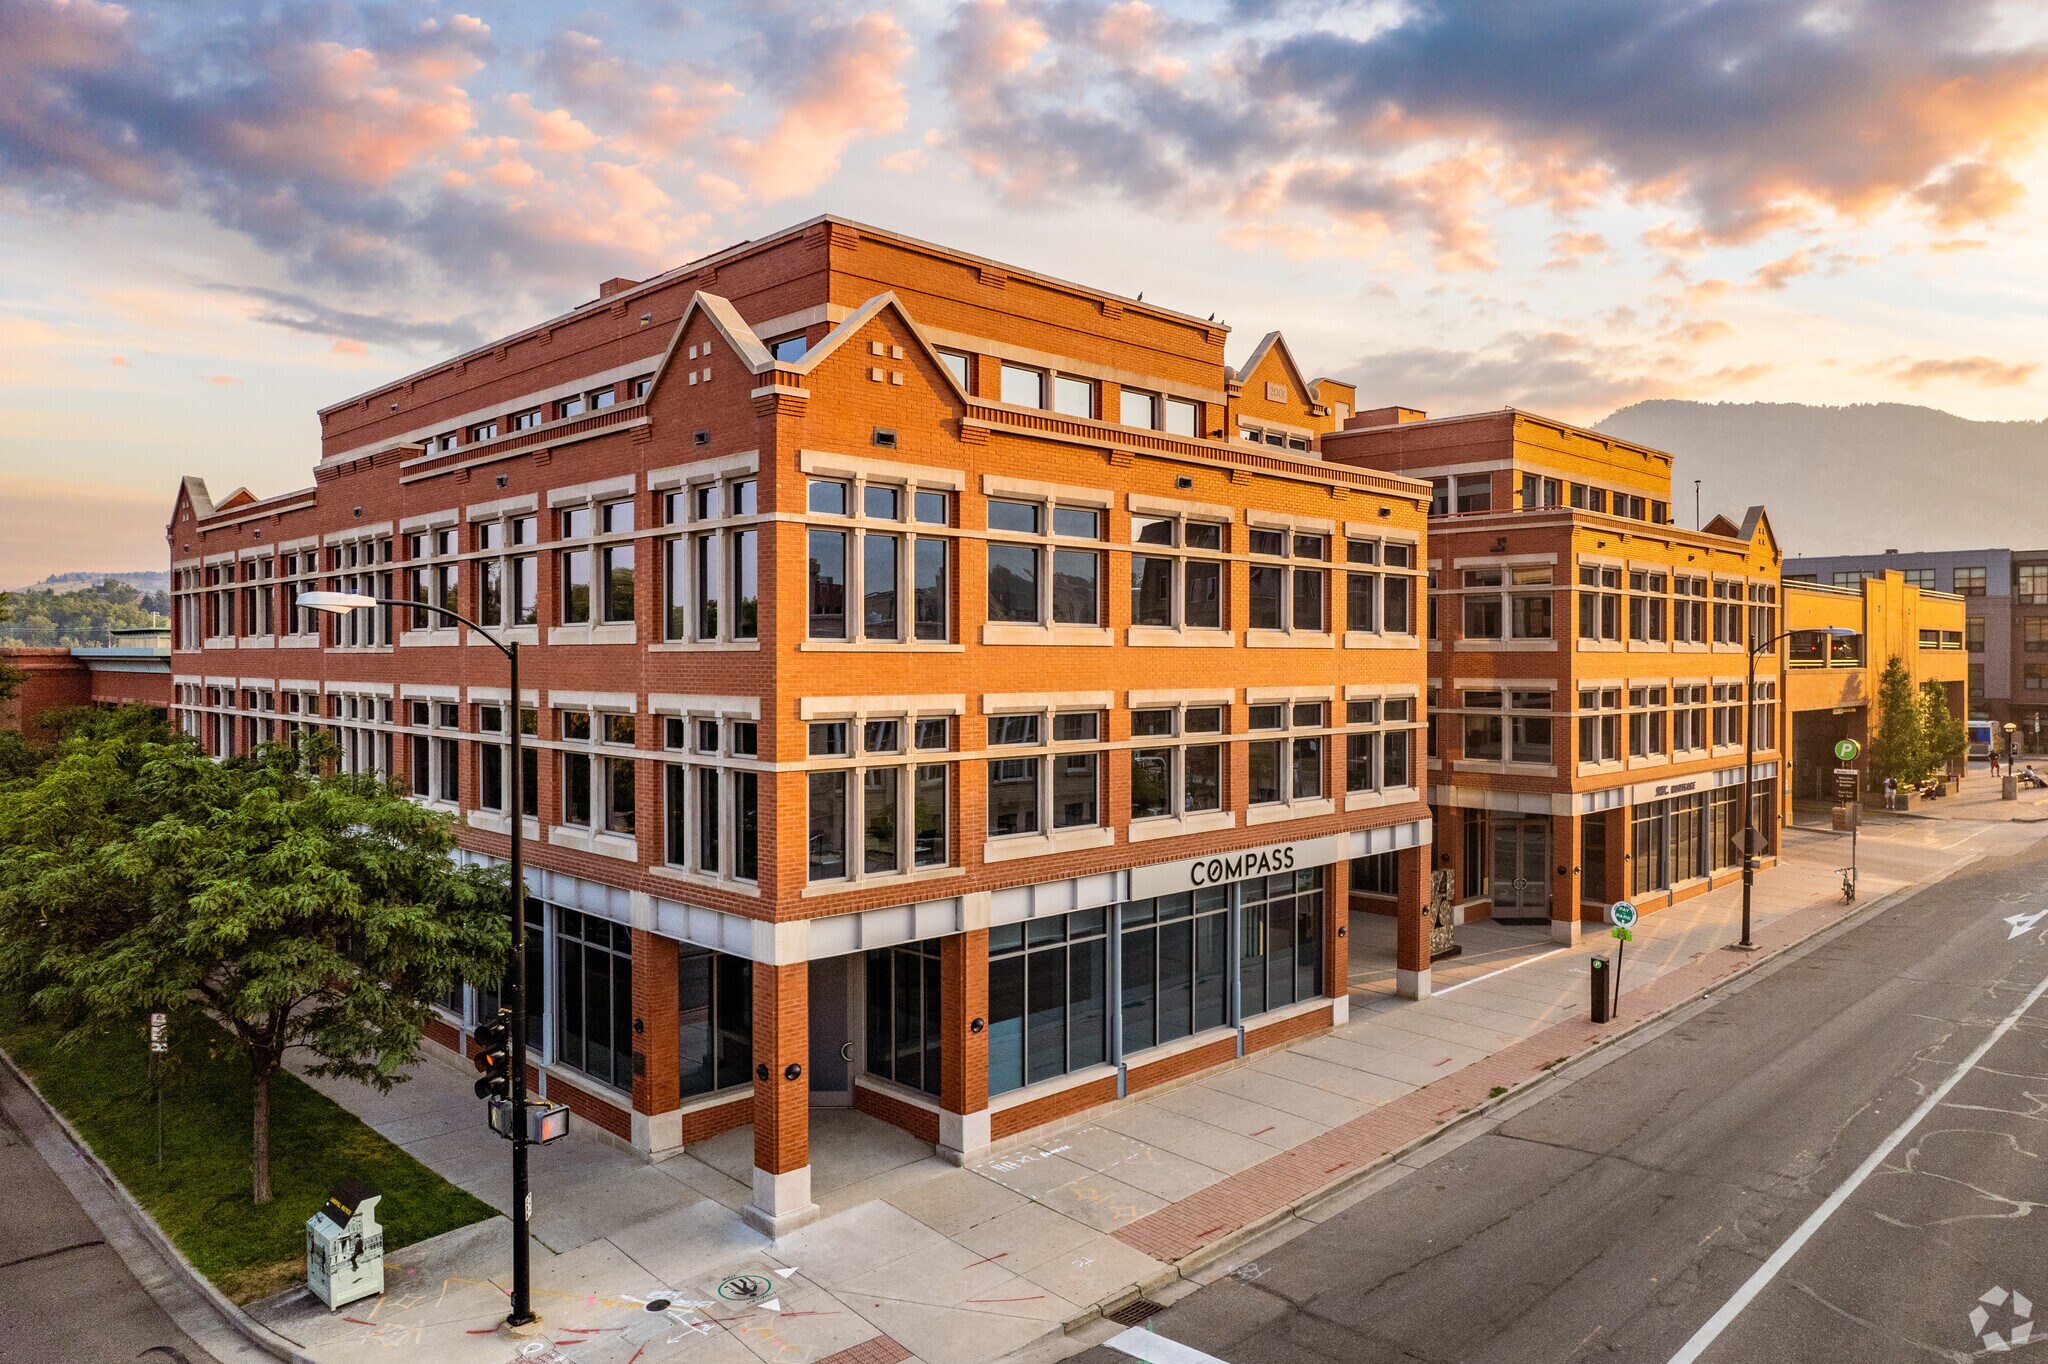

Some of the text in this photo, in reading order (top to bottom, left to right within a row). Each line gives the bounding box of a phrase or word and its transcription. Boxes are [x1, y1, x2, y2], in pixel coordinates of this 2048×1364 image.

[1841, 743, 1853, 757] P
[1191, 846, 1295, 886] COMPASS
[1615, 913, 1631, 921] PARK
